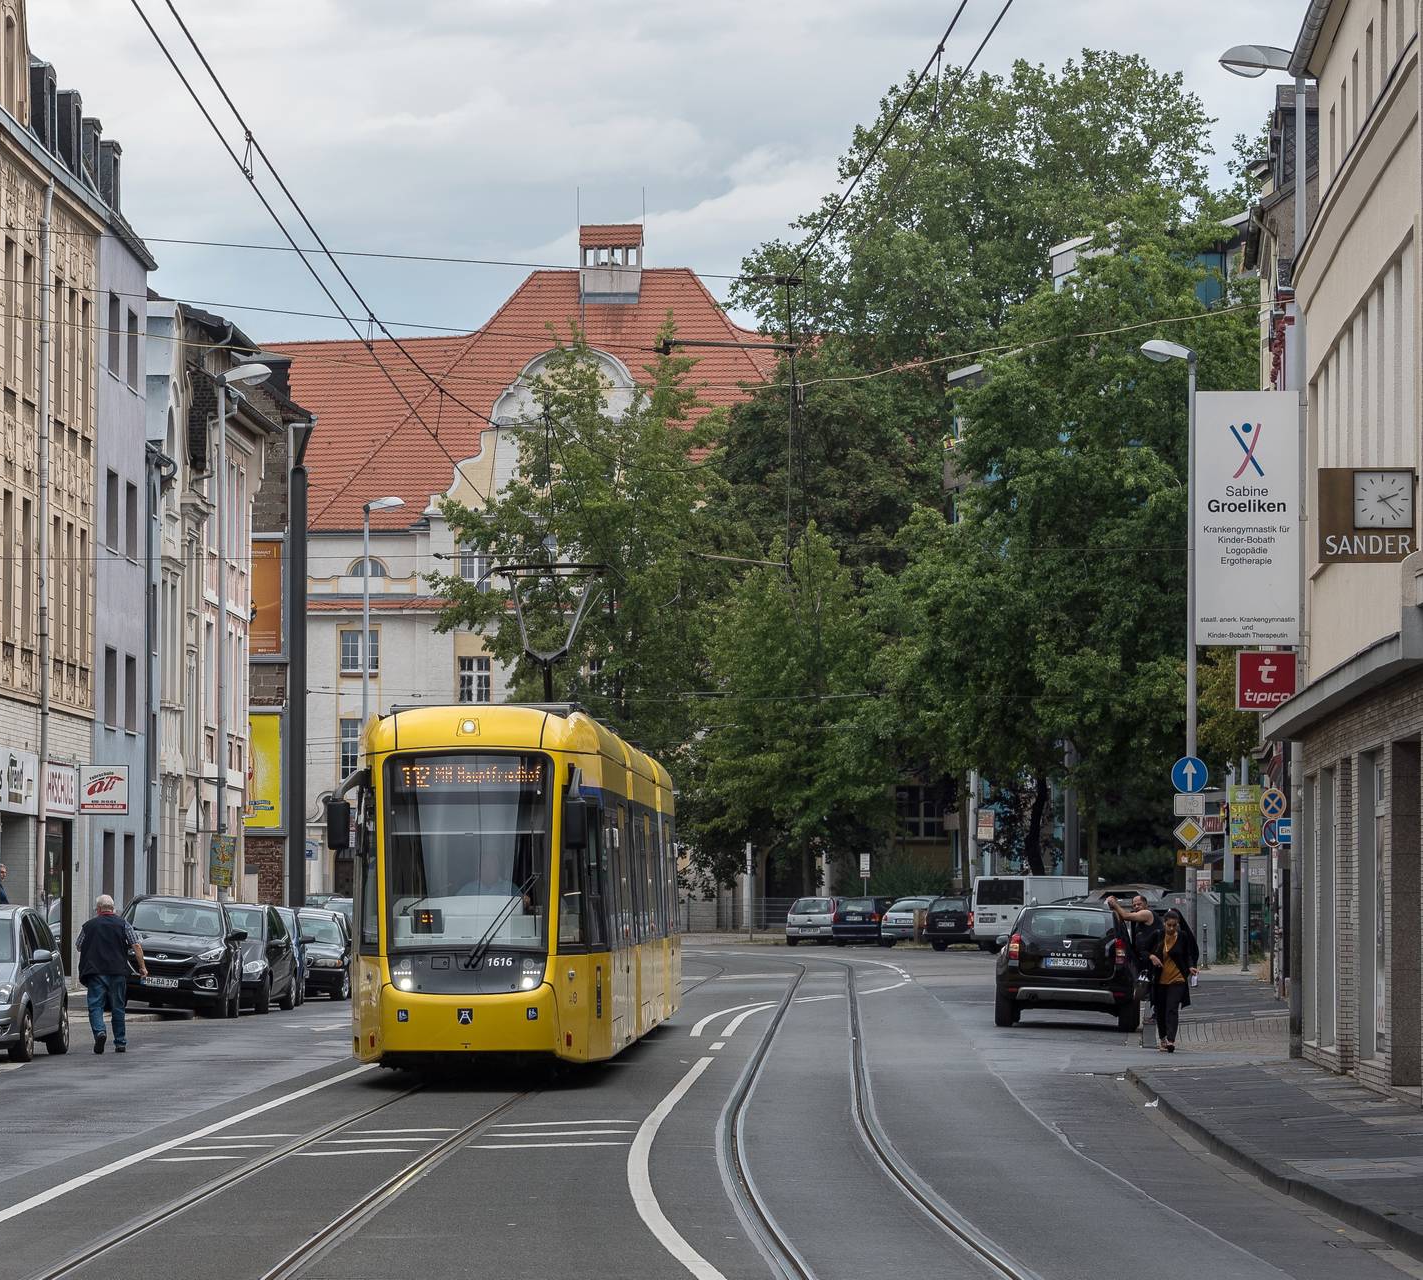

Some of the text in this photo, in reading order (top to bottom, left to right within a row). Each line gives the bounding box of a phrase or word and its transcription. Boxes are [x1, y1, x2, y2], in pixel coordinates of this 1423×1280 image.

[1226, 486, 1268, 497] Sabine
[1208, 499, 1286, 512] Groeliken
[1203, 525, 1289, 534] Krankengymnastik für
[1217, 536, 1275, 544] Kinder-Bobath
[1326, 535, 1411, 555] SANDER
[1225, 547, 1268, 555] Logopädie
[1220, 557, 1272, 566] Ergotherapie
[1244, 688, 1290, 704] tipico
[487, 957, 513, 966] 1616
